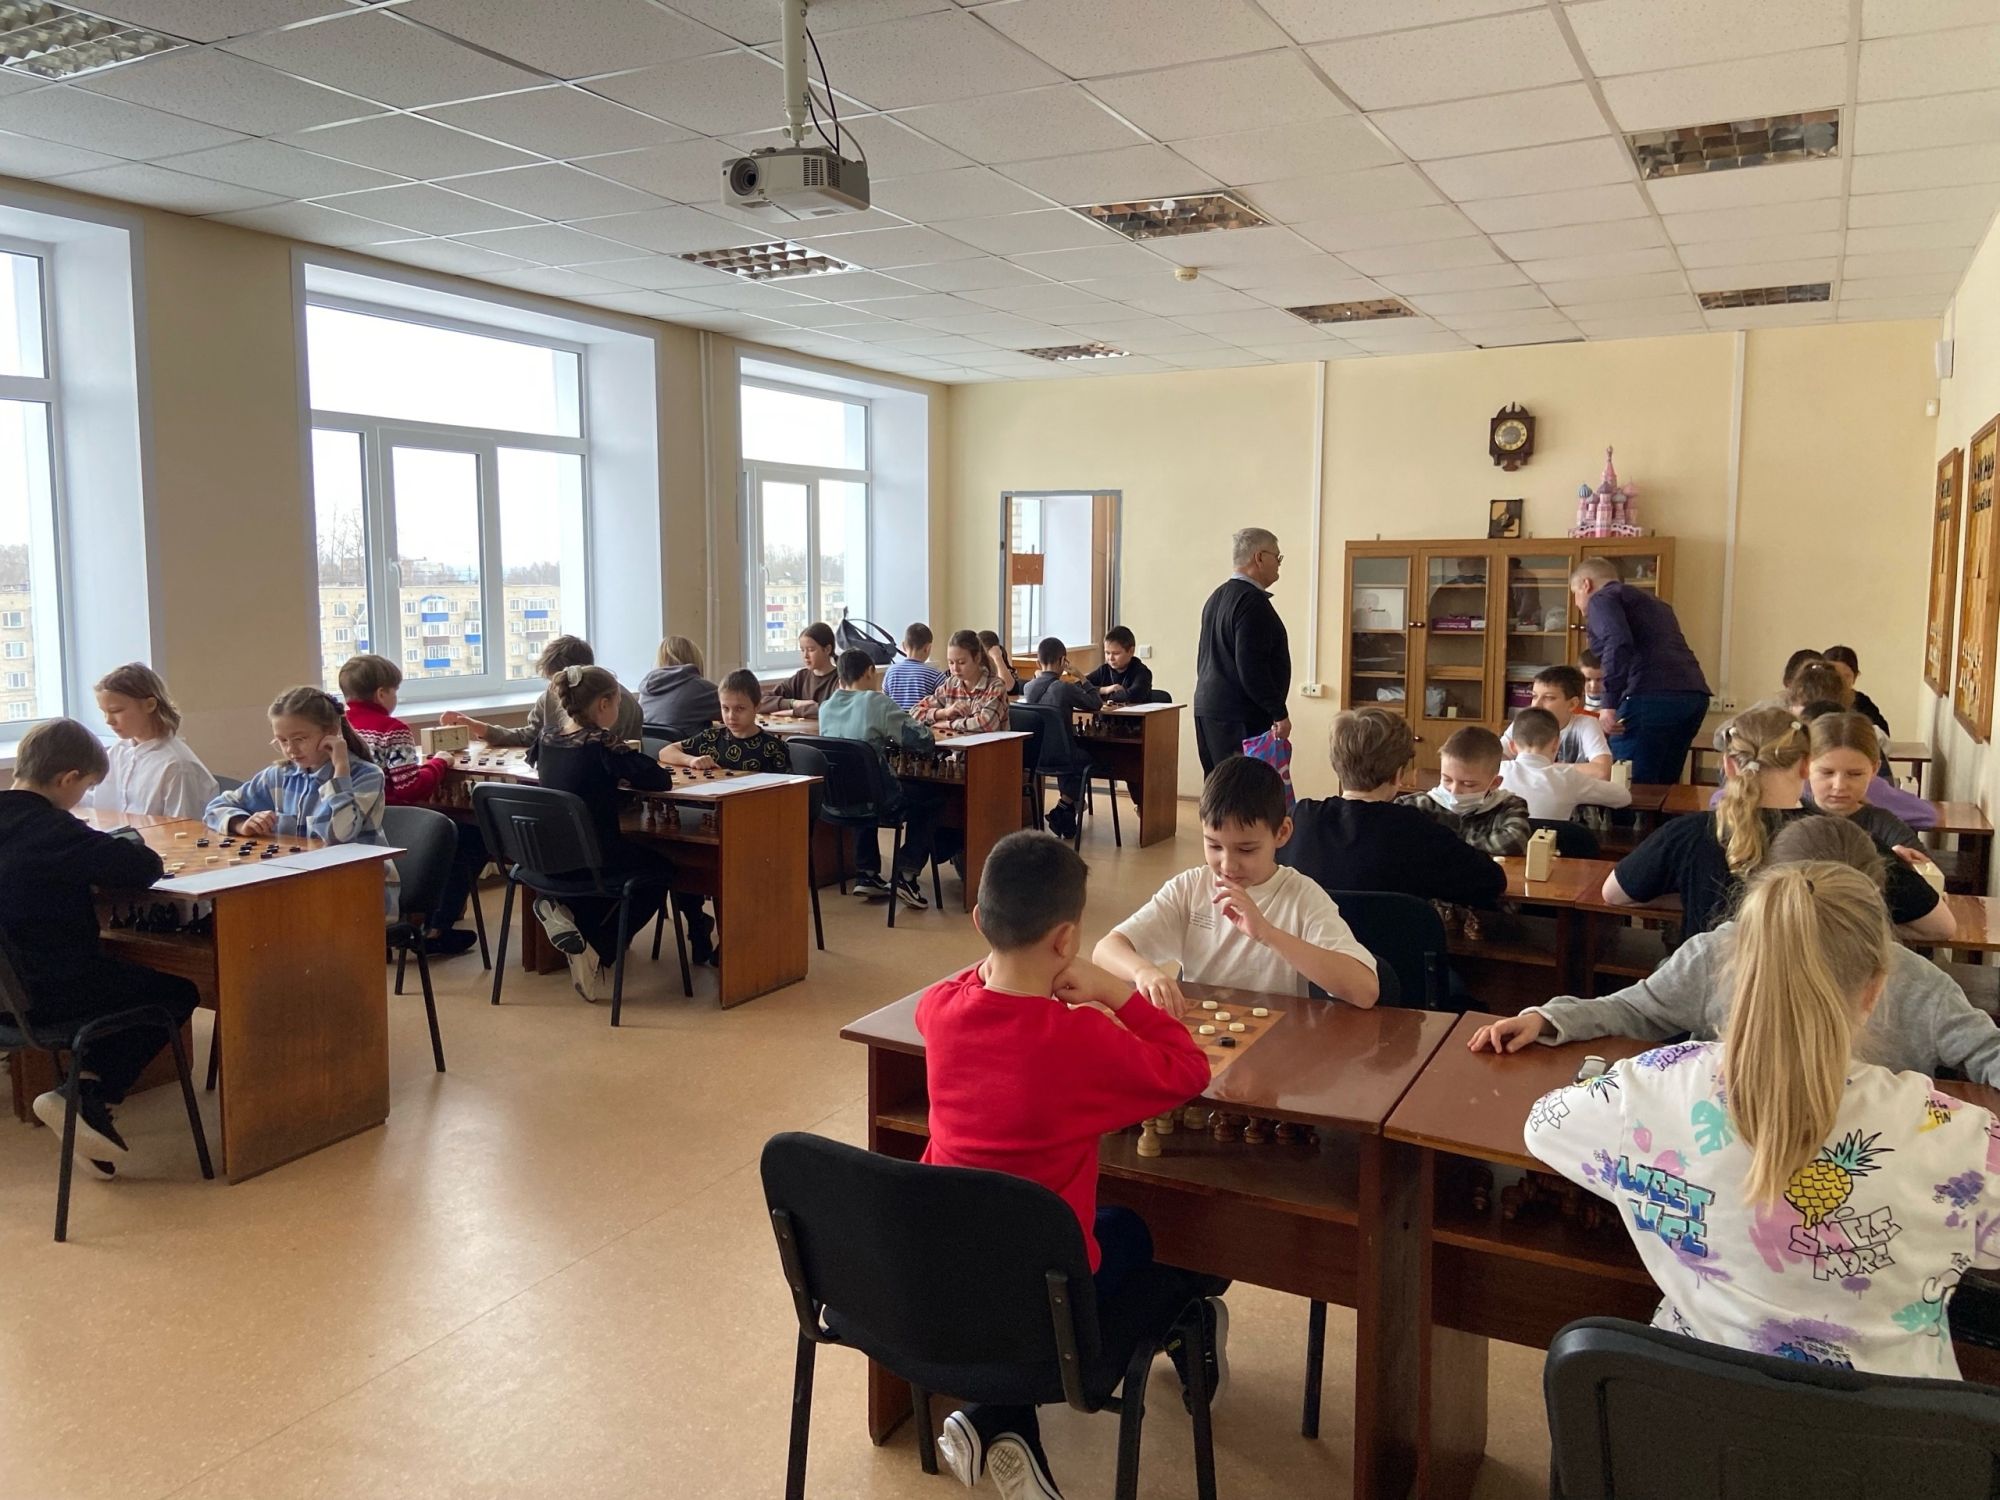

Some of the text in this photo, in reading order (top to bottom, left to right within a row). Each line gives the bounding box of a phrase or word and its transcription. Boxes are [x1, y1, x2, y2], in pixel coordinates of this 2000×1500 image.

[1617, 1155, 1716, 1221] WEET
[1788, 1206, 1903, 1257] SMILE
[1813, 1242, 1896, 1281] MORE
